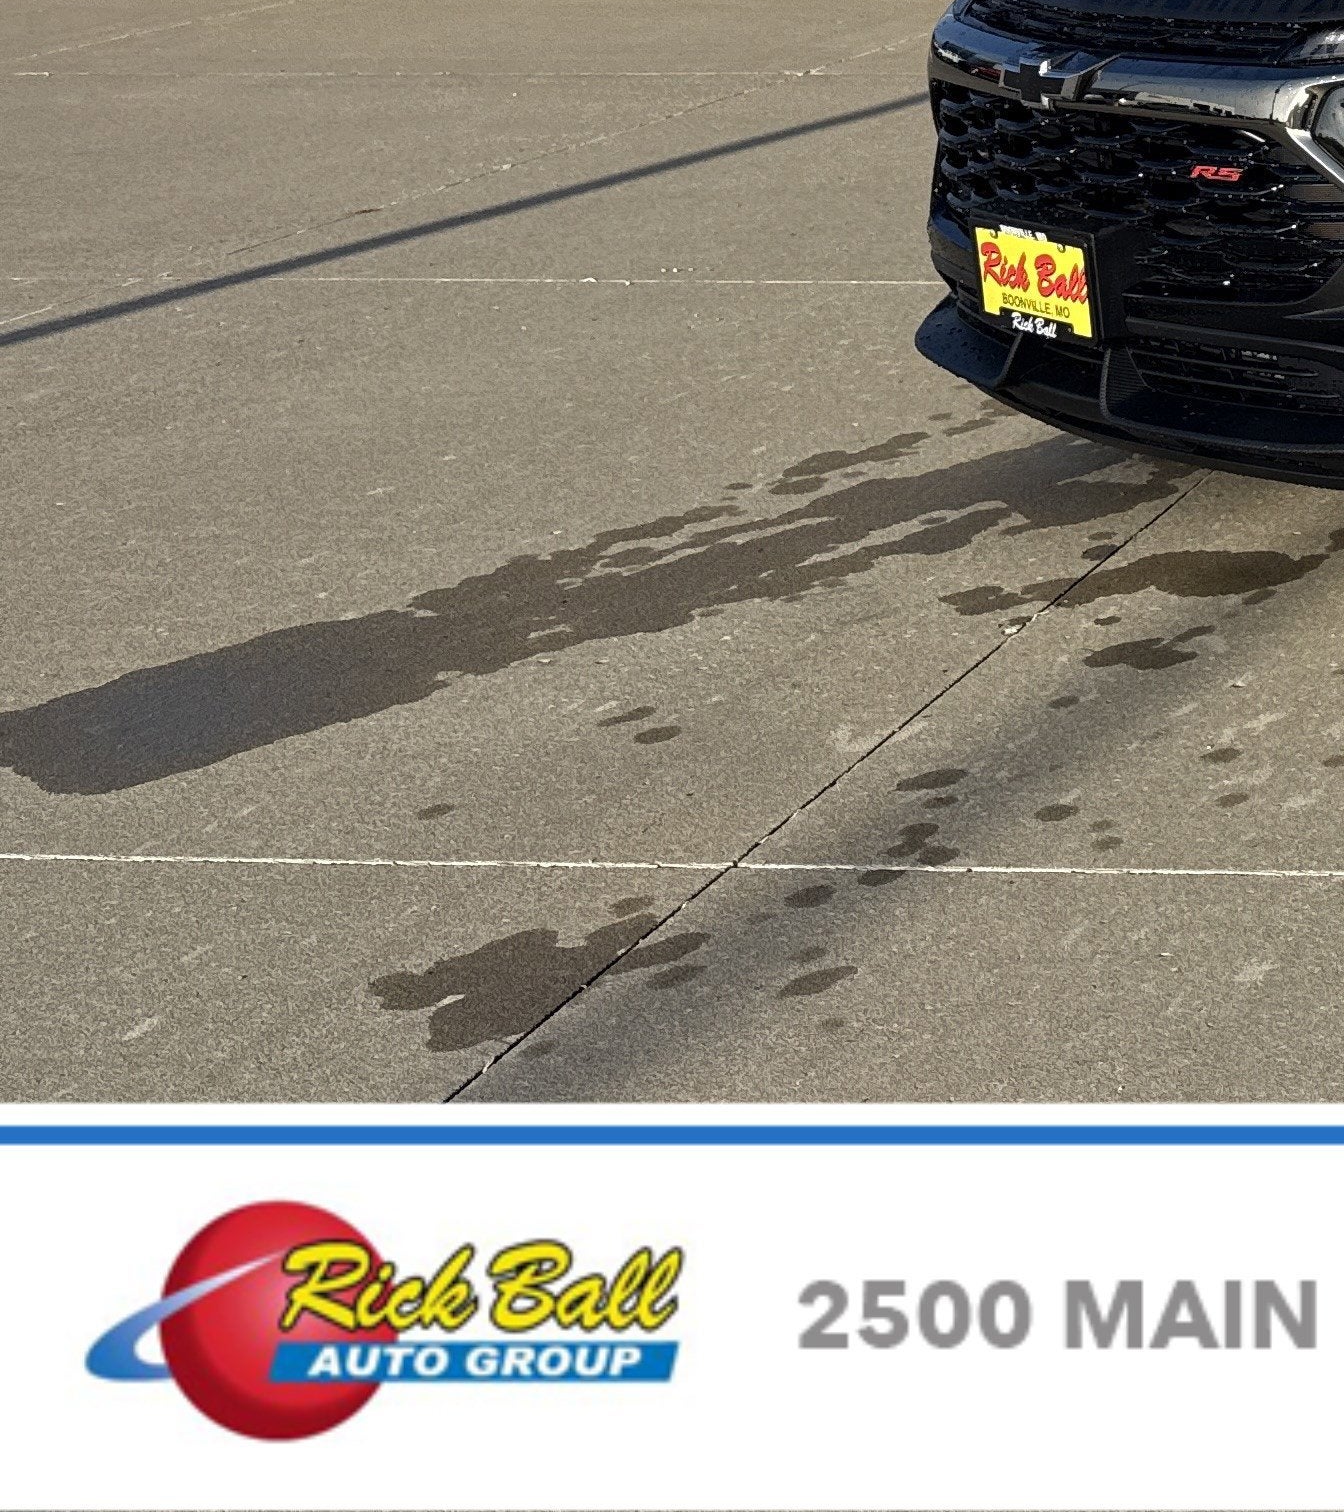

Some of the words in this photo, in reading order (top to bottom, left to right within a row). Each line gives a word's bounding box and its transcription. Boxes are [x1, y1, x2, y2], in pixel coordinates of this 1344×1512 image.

[1190, 165, 1244, 182] RS
[981, 242, 1030, 293] Rick
[1034, 254, 1088, 305] Ball
[1056, 304, 1071, 319] MO
[1011, 311, 1034, 334] Rick
[1034, 318, 1058, 339] Ball
